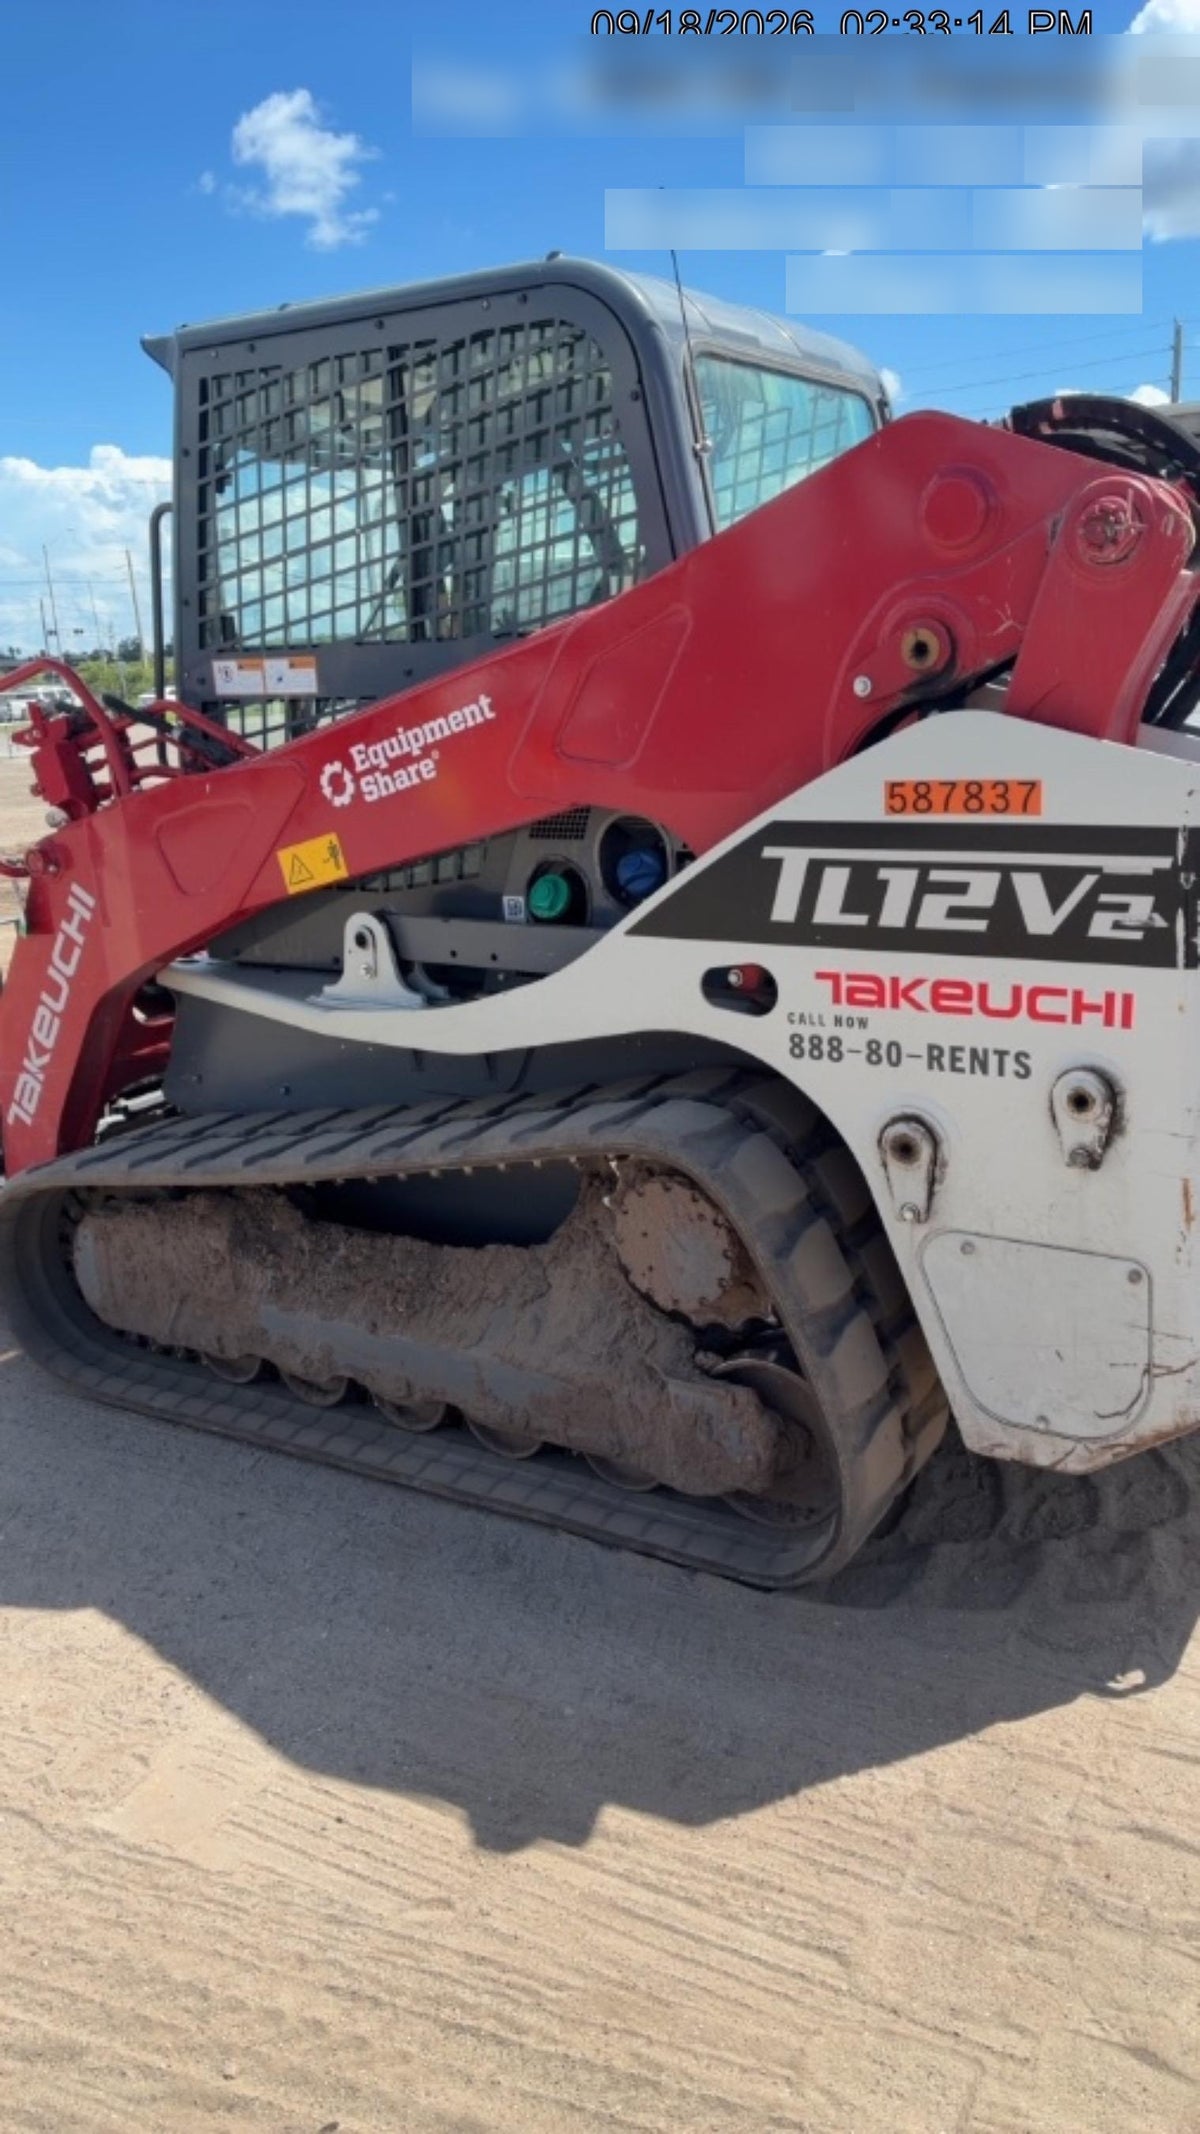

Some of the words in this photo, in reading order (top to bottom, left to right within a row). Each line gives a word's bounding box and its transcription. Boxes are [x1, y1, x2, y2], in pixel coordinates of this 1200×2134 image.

[349, 694, 496, 773] Equipment
[888, 781, 1037, 813] 587837
[787, 1012, 826, 1027] CALL
[834, 1014, 869, 1030] NOW
[789, 1033, 1032, 1080] 888-80-RENTS
